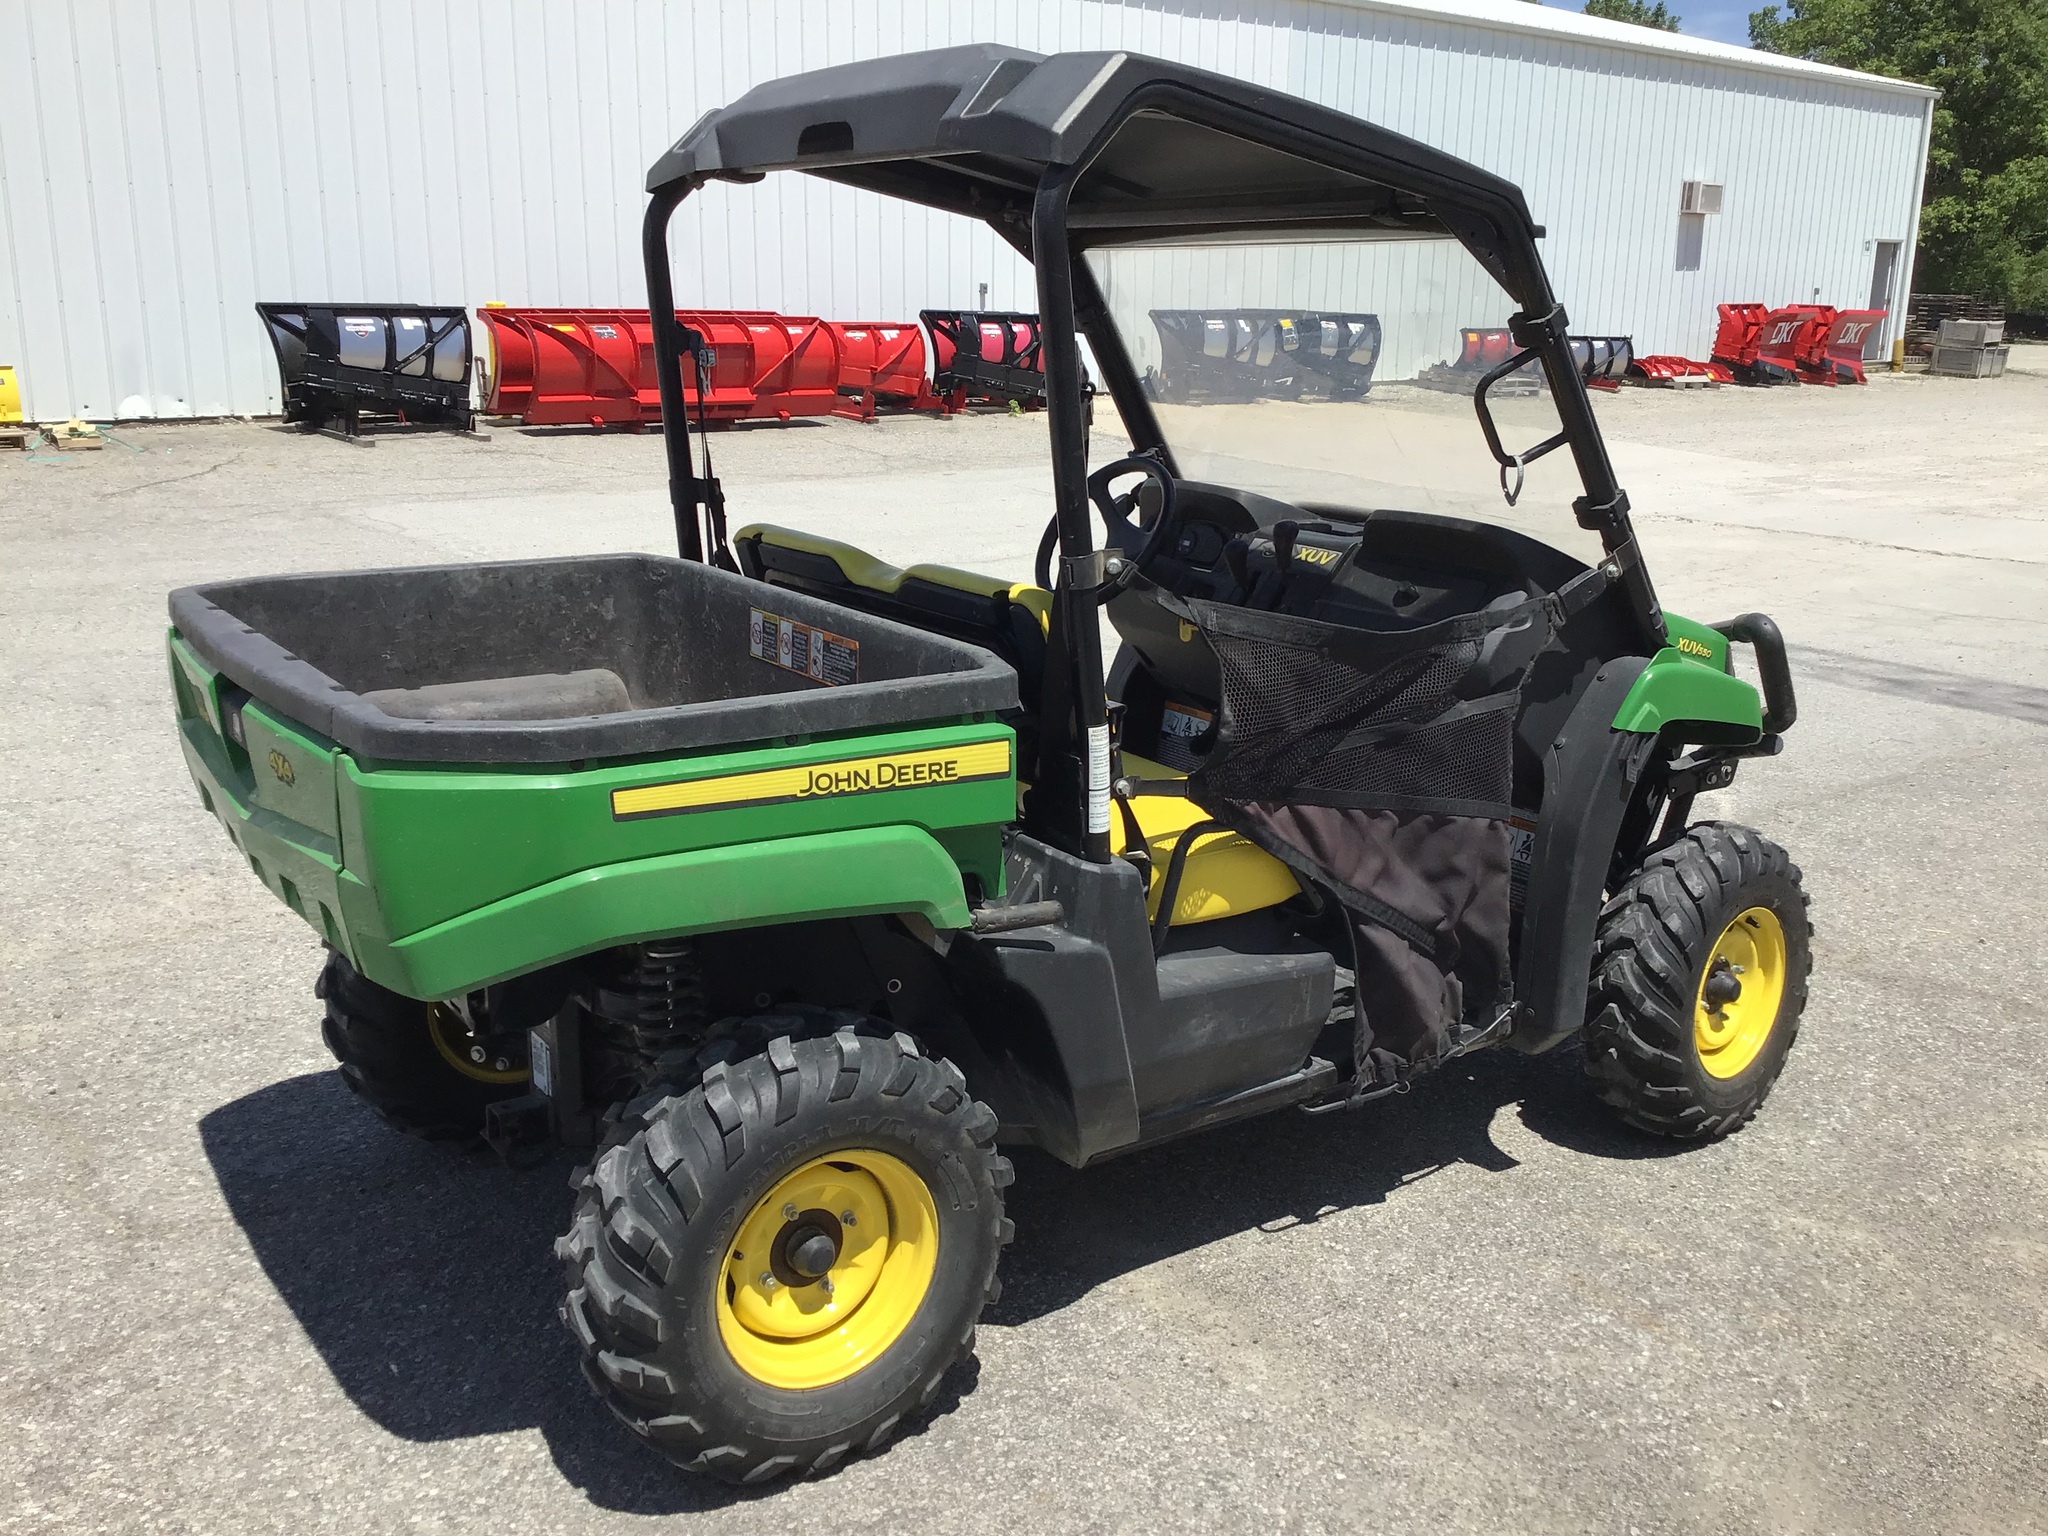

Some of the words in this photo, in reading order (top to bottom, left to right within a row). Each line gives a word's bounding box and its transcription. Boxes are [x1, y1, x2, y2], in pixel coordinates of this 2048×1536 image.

[1768, 321, 1804, 345] DXT
[1836, 322, 1873, 344] DXT
[1294, 546, 1338, 566] XUV
[1677, 637, 1713, 660] XUV550
[799, 768, 871, 795] JOHN
[877, 760, 958, 788] DEERE
